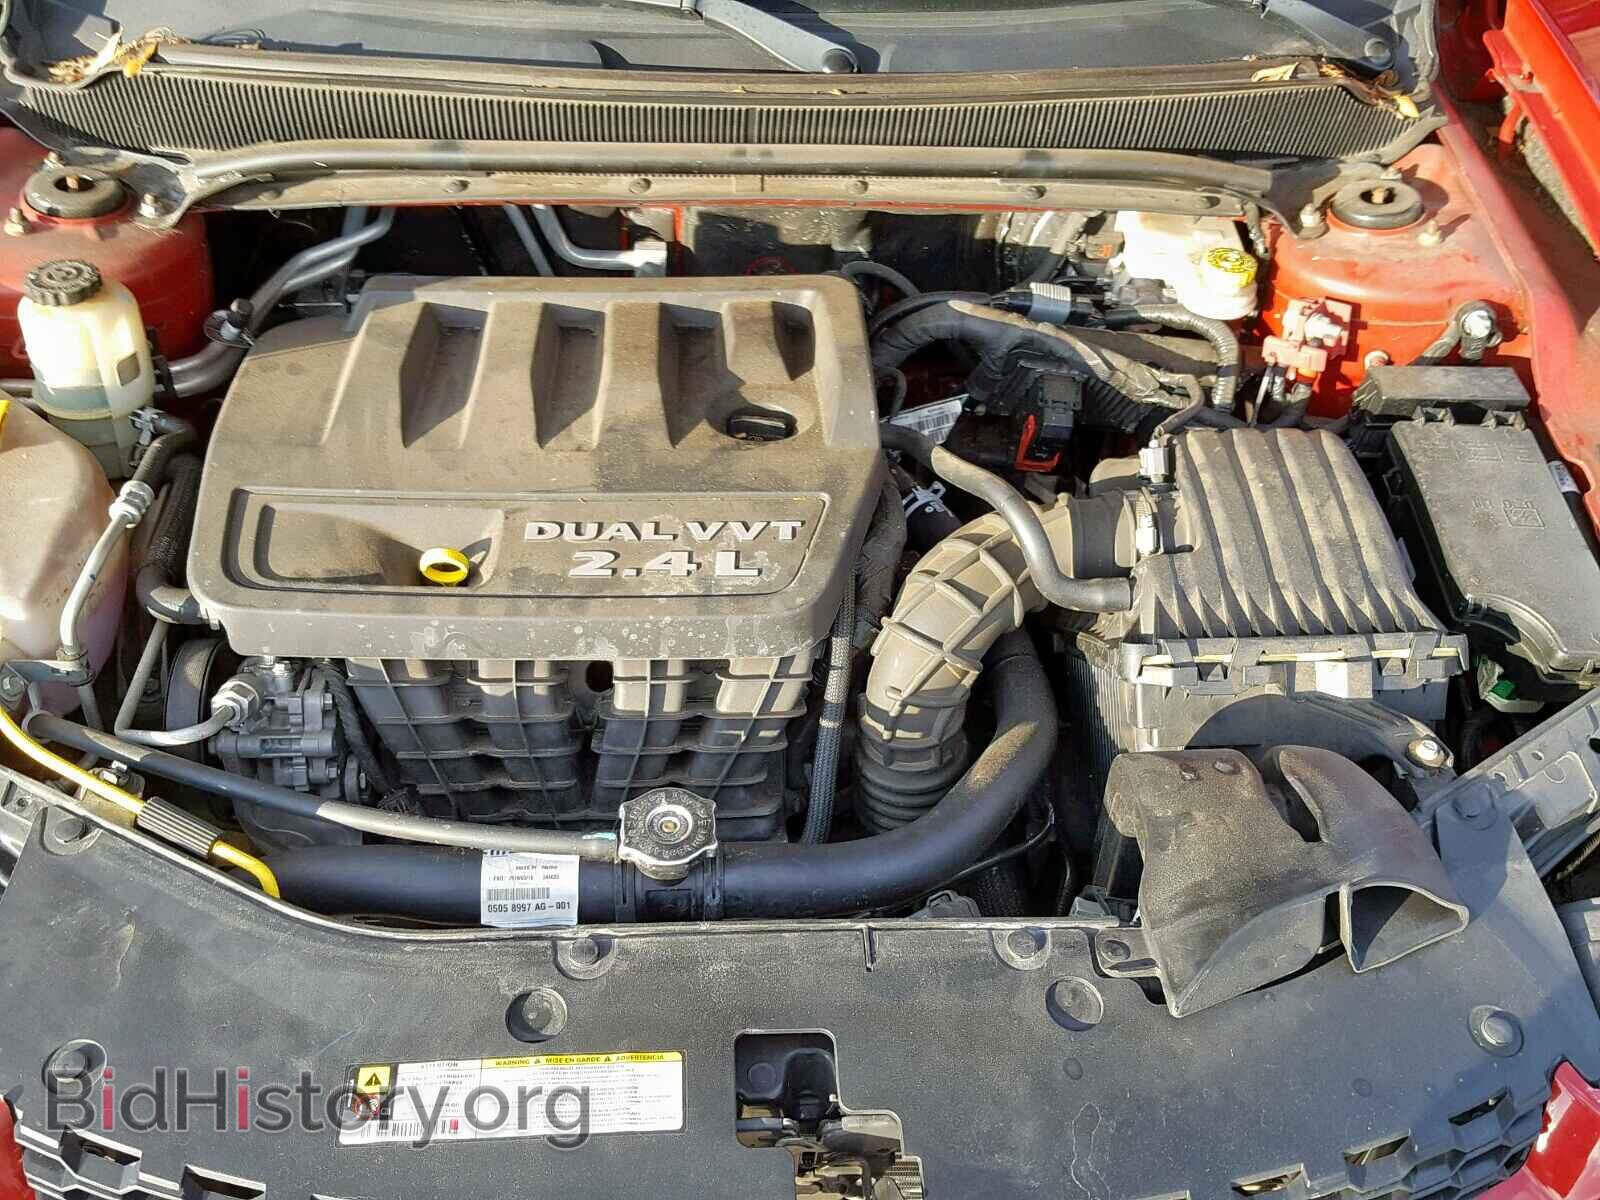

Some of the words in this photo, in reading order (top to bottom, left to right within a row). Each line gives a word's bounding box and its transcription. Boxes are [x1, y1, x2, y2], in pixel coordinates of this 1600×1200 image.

[524, 520, 677, 541] DUAL
[686, 519, 804, 541] VVT
[487, 903, 508, 913] 0505
[511, 903, 531, 913] 8997
